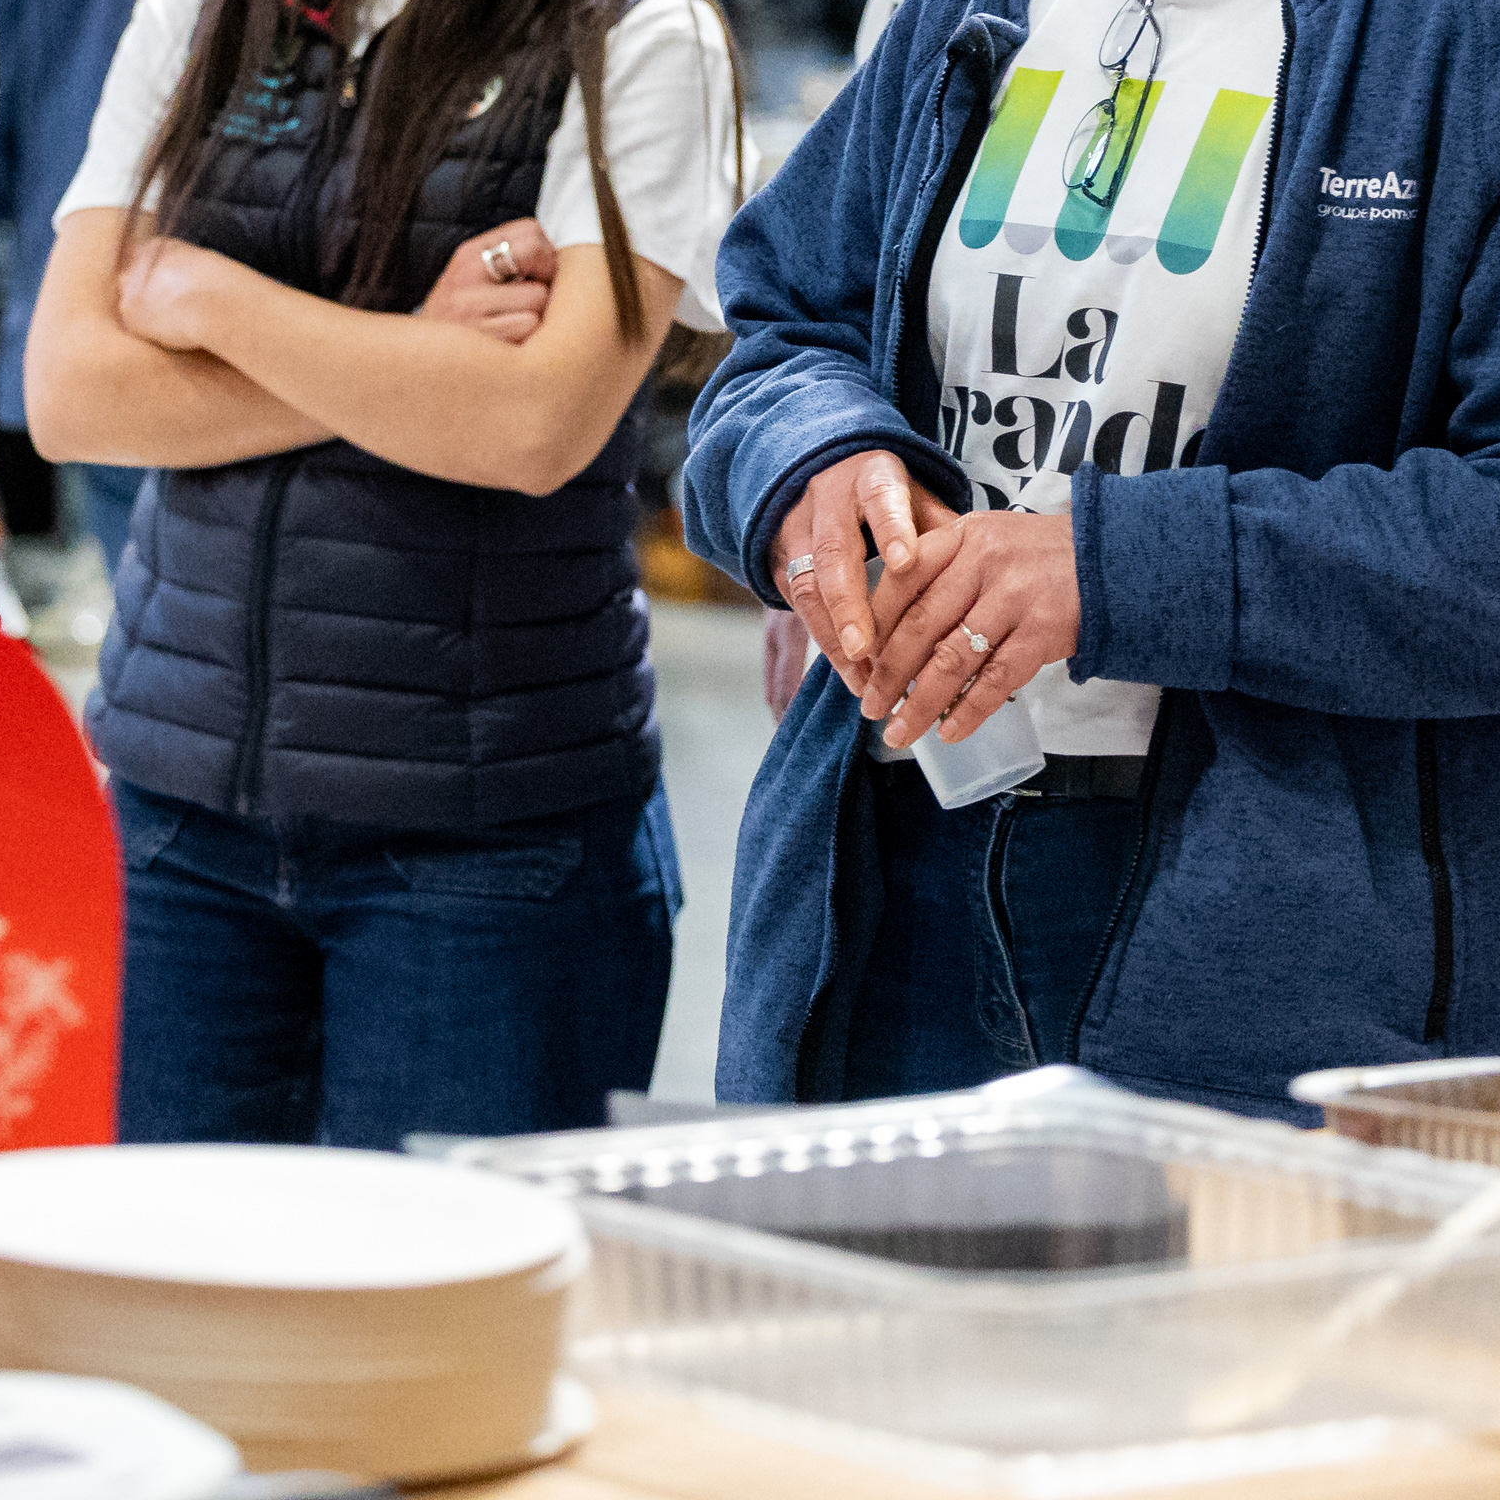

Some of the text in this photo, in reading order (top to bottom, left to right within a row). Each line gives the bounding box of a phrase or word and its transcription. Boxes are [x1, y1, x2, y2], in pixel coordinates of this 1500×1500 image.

[1317, 203, 1368, 220] groupe
[981, 271, 1119, 385] La
[939, 379, 1206, 478] rand
